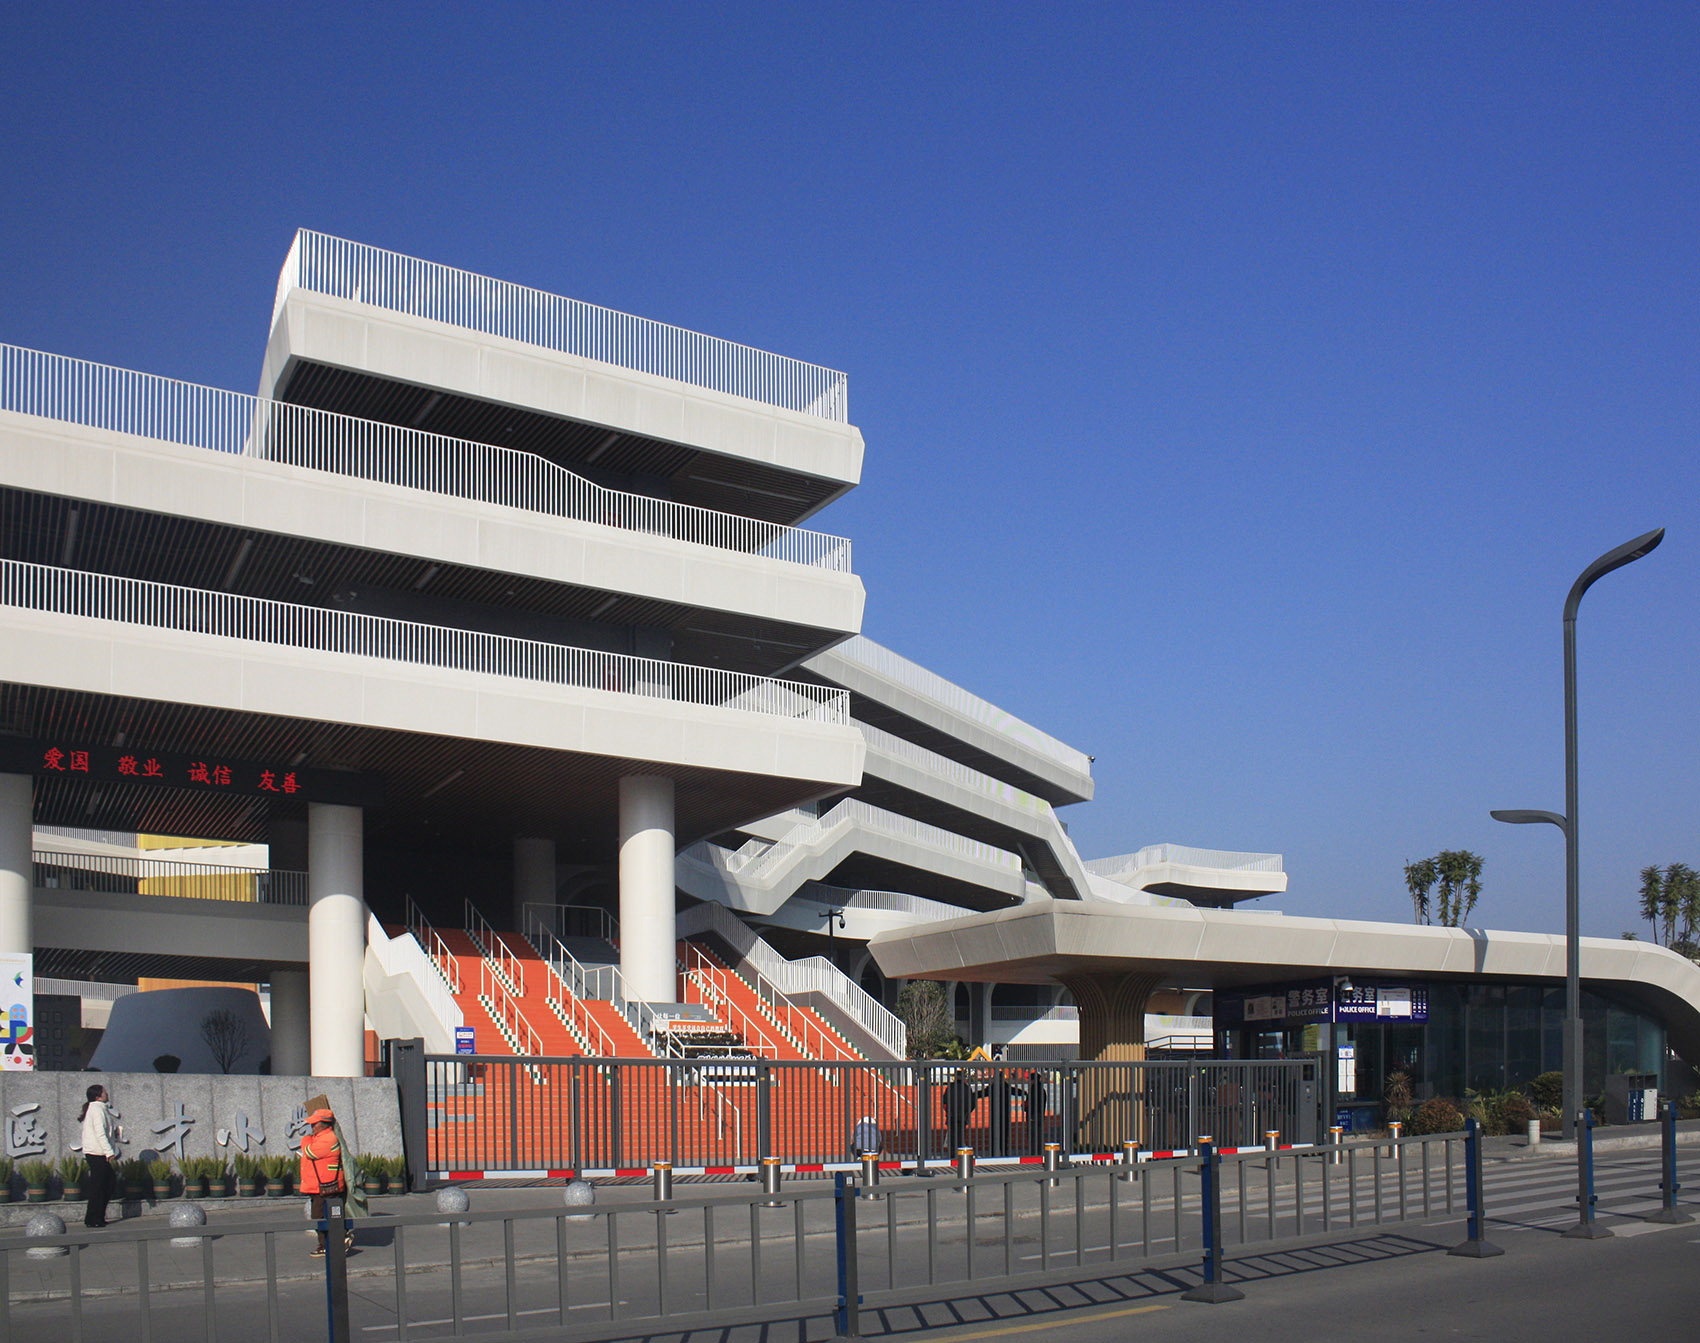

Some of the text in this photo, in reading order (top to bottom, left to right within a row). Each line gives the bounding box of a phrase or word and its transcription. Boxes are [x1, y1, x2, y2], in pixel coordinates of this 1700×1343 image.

[43, 747, 302, 794] 爱国 敬业 诚信 友善
[1288, 987, 1329, 1007] 警务室
[1287, 1006, 1329, 1017] POLICE OFFICE
[1358, 1006, 1376, 1014] OFFICE
